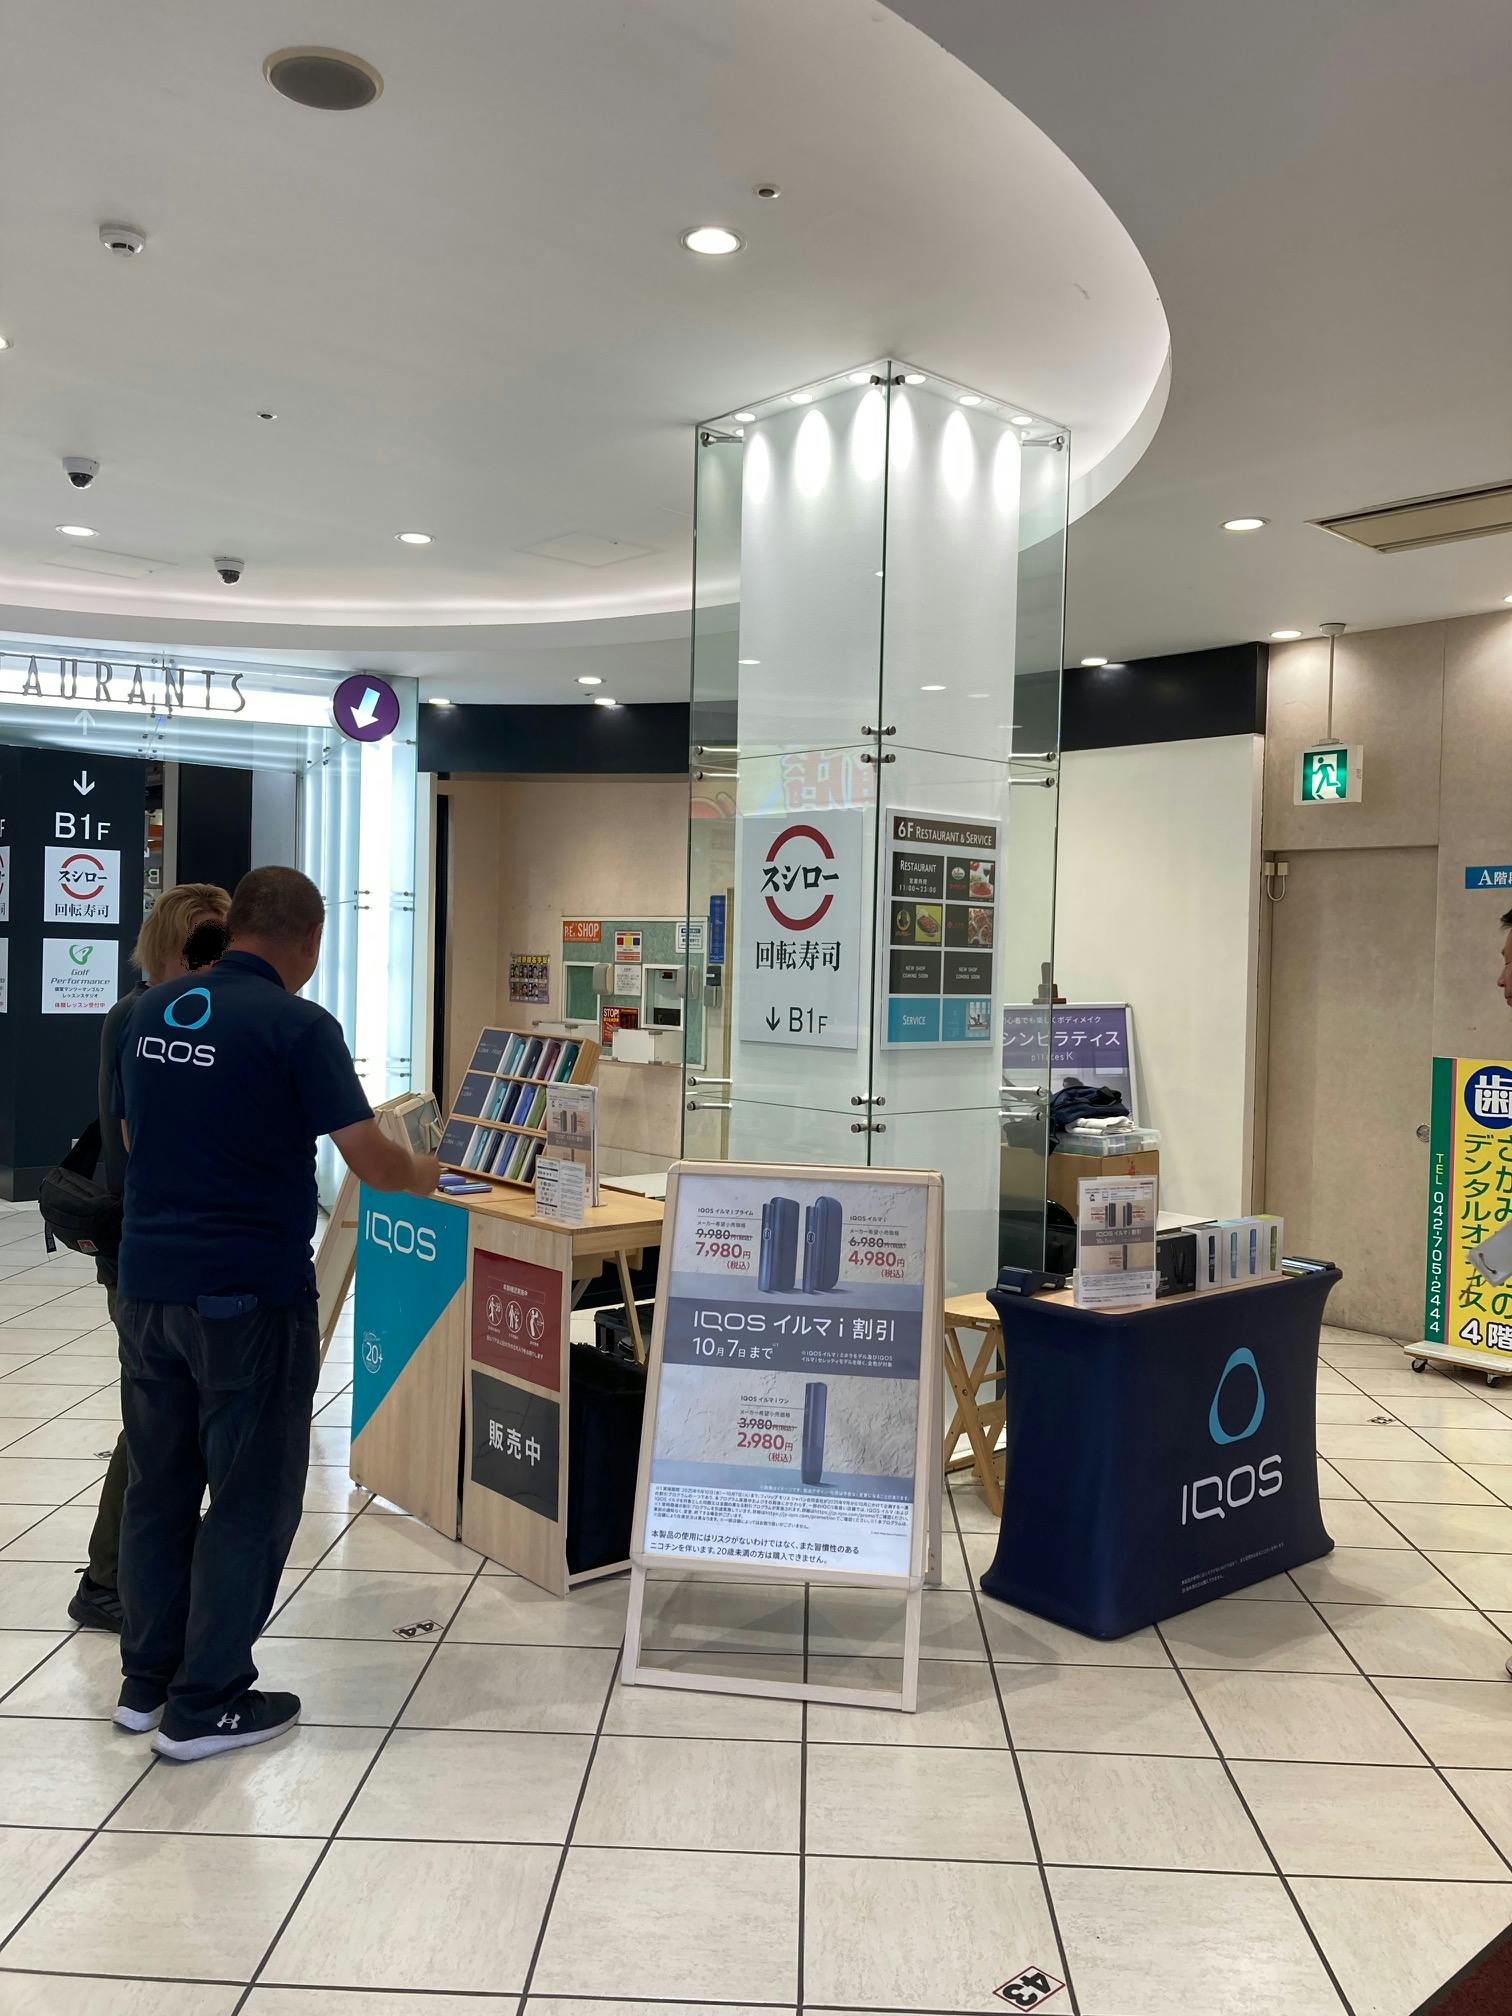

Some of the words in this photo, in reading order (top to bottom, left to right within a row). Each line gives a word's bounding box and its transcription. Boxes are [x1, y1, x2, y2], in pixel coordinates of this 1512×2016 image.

[0, 653, 245, 712] AURANTS
[55, 812, 111, 841] B1F
[898, 821, 914, 838] 6F
[916, 827, 959, 843] RESTAURANT
[966, 832, 992, 846] SERVICE
[58, 870, 107, 883] スシロー
[761, 864, 839, 892] スシロー
[900, 860, 936, 873] RESTAURANT
[55, 904, 109, 918] 回転寿司
[577, 922, 599, 938] SHOP
[756, 940, 841, 971] 回転寿司
[789, 1007, 828, 1034] B1F
[903, 1015, 926, 1026] SERVICE
[137, 1037, 216, 1067] IQOS
[1434, 1153, 1445, 1185] TEL
[365, 1210, 437, 1262] IQOS
[695, 1241, 751, 1259] 7,980円
[848, 1250, 905, 1268] 4,980円
[1429, 1191, 1445, 1333] 042-705-2444
[694, 1310, 766, 1332] IQOS
[773, 1315, 832, 1337] イルマ
[852, 1318, 895, 1341] 割引
[489, 1418, 541, 1467] 販売中
[737, 1431, 794, 1452] 2,980円
[1181, 1454, 1283, 1525] IQOS
[1002, 1972, 1051, 2006] 43
